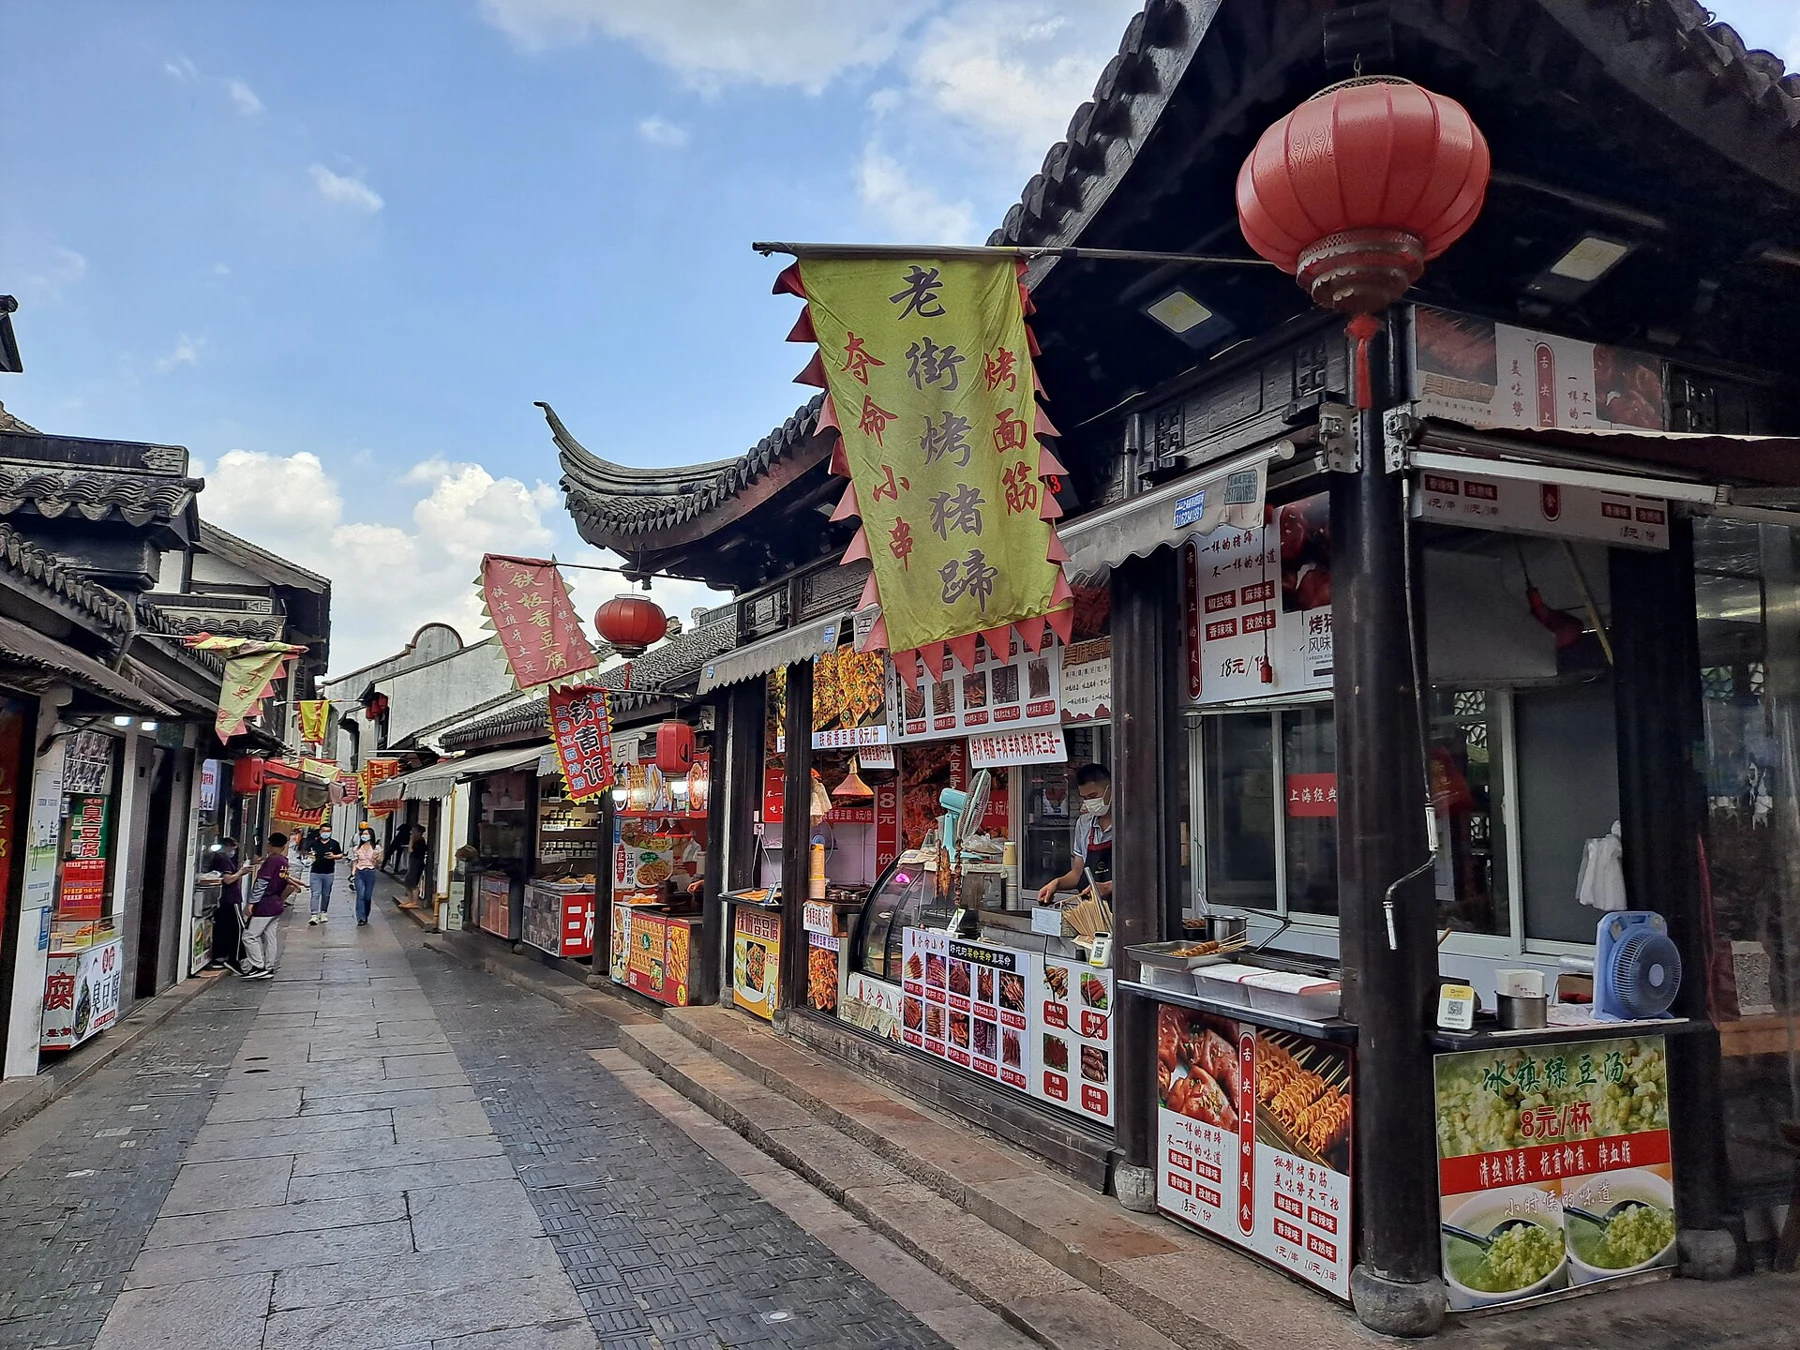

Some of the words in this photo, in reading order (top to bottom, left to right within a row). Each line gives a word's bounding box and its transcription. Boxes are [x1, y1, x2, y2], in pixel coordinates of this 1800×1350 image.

[1511, 359, 1525, 427] 美味势
[1567, 376, 1579, 428] 一样的
[1579, 391, 1592, 428] 不一
[841, 332, 913, 571] 夺命小串
[889, 265, 998, 612] 老街烤猪蹄
[984, 347, 1038, 517] 烤面筋
[1211, 550, 1277, 578] 不一样的味道
[507, 569, 568, 672] 铁板香豆腐
[1208, 620, 1235, 639] 香辣味
[1307, 634, 1332, 653] 风味
[818, 732, 856, 746] 铁板香豆腐
[1289, 785, 1337, 803] 上海经典
[78, 805, 103, 858] 臭豆腐
[878, 782, 896, 865] 8元一份
[737, 909, 779, 942] 铁板香豆腐
[91, 969, 121, 1019] 臭豆腐
[1482, 1052, 1625, 1098] 冰镇绿豆汤
[1241, 1047, 1252, 1221] 舌尖上的美食
[1520, 1100, 1593, 1139] 8元/杯
[1166, 1136, 1223, 1167] 不一样的味道
[1169, 1150, 1192, 1170] 椒盐味
[1198, 1162, 1221, 1183] 麻辣味
[1169, 1173, 1191, 1193] 香辣味
[1197, 1185, 1221, 1206] 孜然味
[1273, 1172, 1341, 1212] 美味势不可挡
[1504, 1181, 1614, 1217] 小时候的味道
[1275, 1194, 1301, 1217] 椒盐味
[1309, 1209, 1336, 1232] 麻辣味
[1275, 1222, 1301, 1243] 香辣味
[1309, 1236, 1335, 1260] 孜然味
[1274, 1244, 1300, 1264] 4元/串
[1303, 1258, 1338, 1284] 10元/3串
